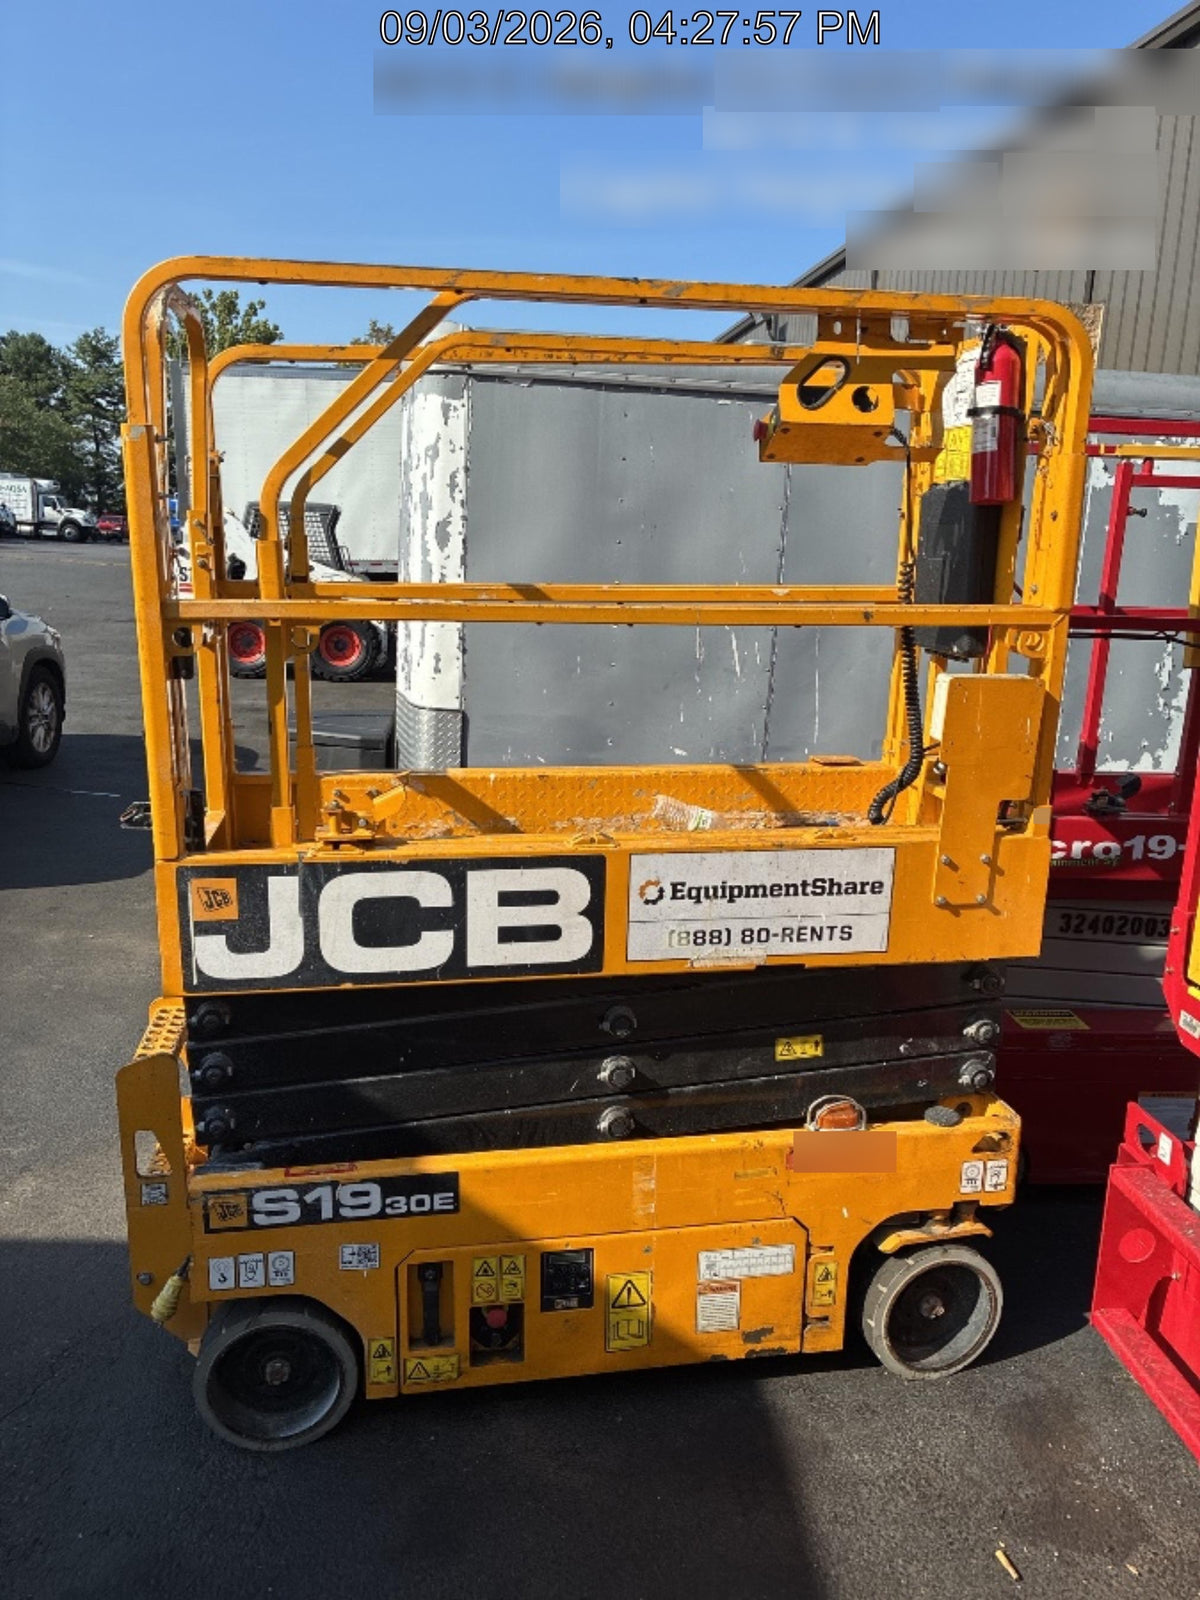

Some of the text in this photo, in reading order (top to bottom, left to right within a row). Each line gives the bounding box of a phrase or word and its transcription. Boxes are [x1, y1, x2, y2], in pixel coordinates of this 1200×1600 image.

[202, 889, 230, 909] JCB
[669, 877, 885, 904] EquipmentShare
[194, 867, 593, 980] JCB
[667, 925, 853, 948] (888) 80-RENTS
